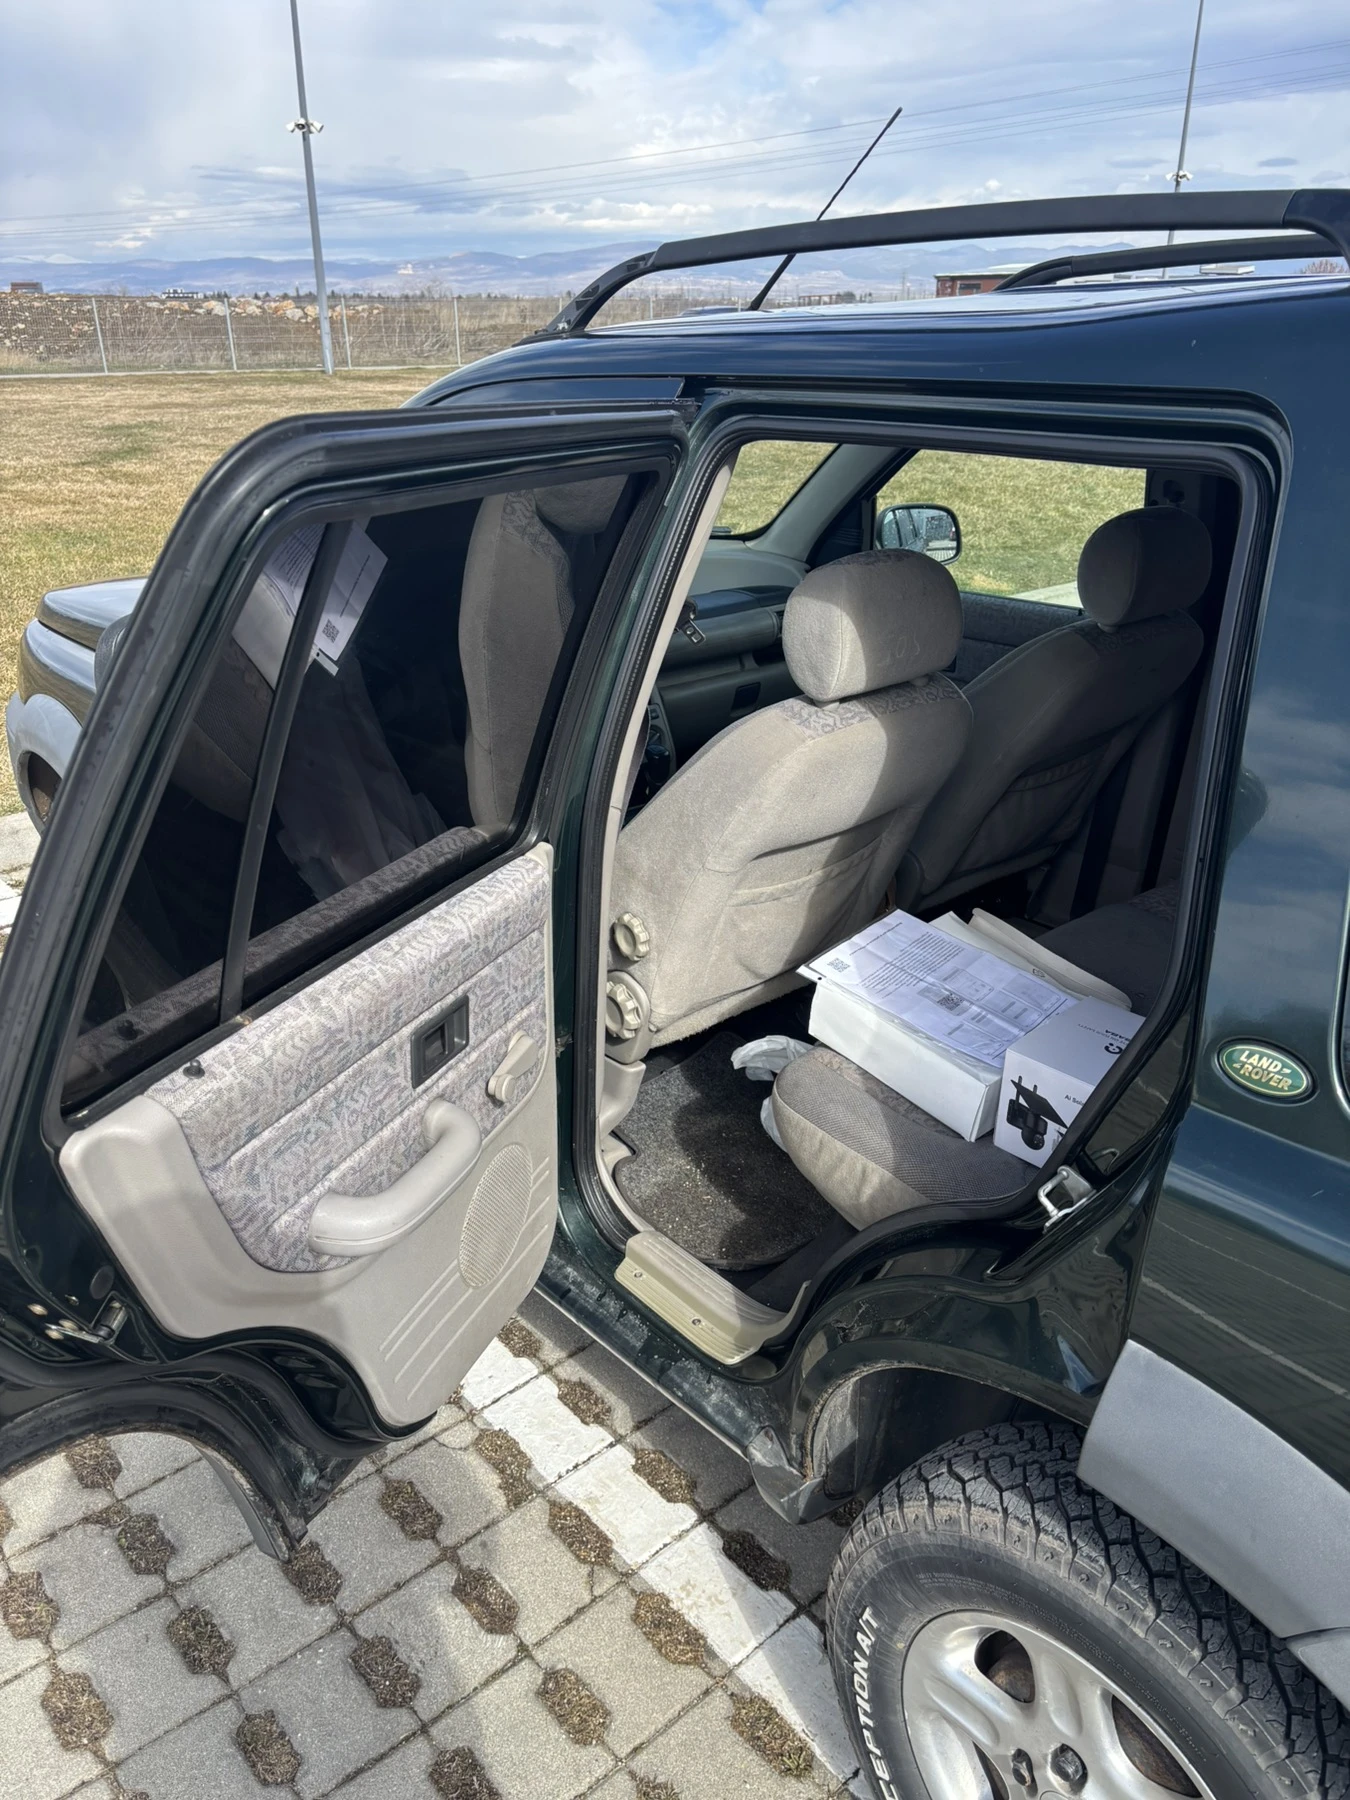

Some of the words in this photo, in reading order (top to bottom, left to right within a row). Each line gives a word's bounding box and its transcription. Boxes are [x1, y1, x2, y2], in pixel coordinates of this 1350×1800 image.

[1239, 1050, 1282, 1073] LAND
[1239, 1064, 1293, 1091] ROVER
[855, 1606, 879, 1656] A/T
